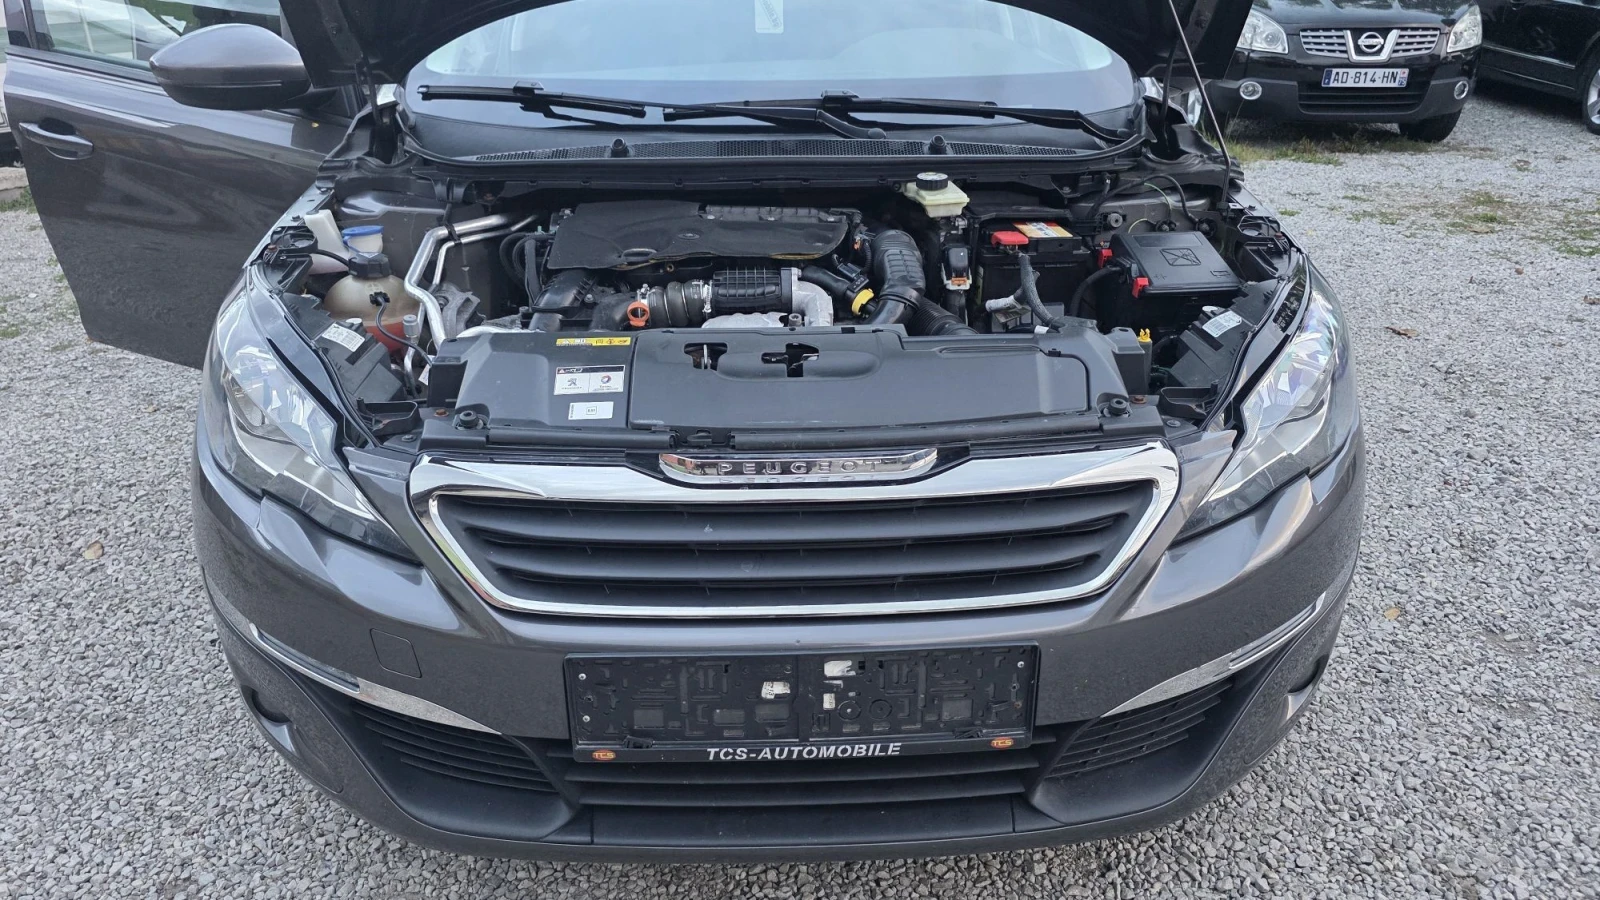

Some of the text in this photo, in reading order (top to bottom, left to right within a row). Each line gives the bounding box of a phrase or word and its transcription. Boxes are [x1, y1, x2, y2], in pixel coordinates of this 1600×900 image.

[1332, 71, 1398, 84] AD-814-HN
[717, 458, 882, 475] PEUGEOT
[706, 743, 902, 761] TCS-AUTOMOBILE
